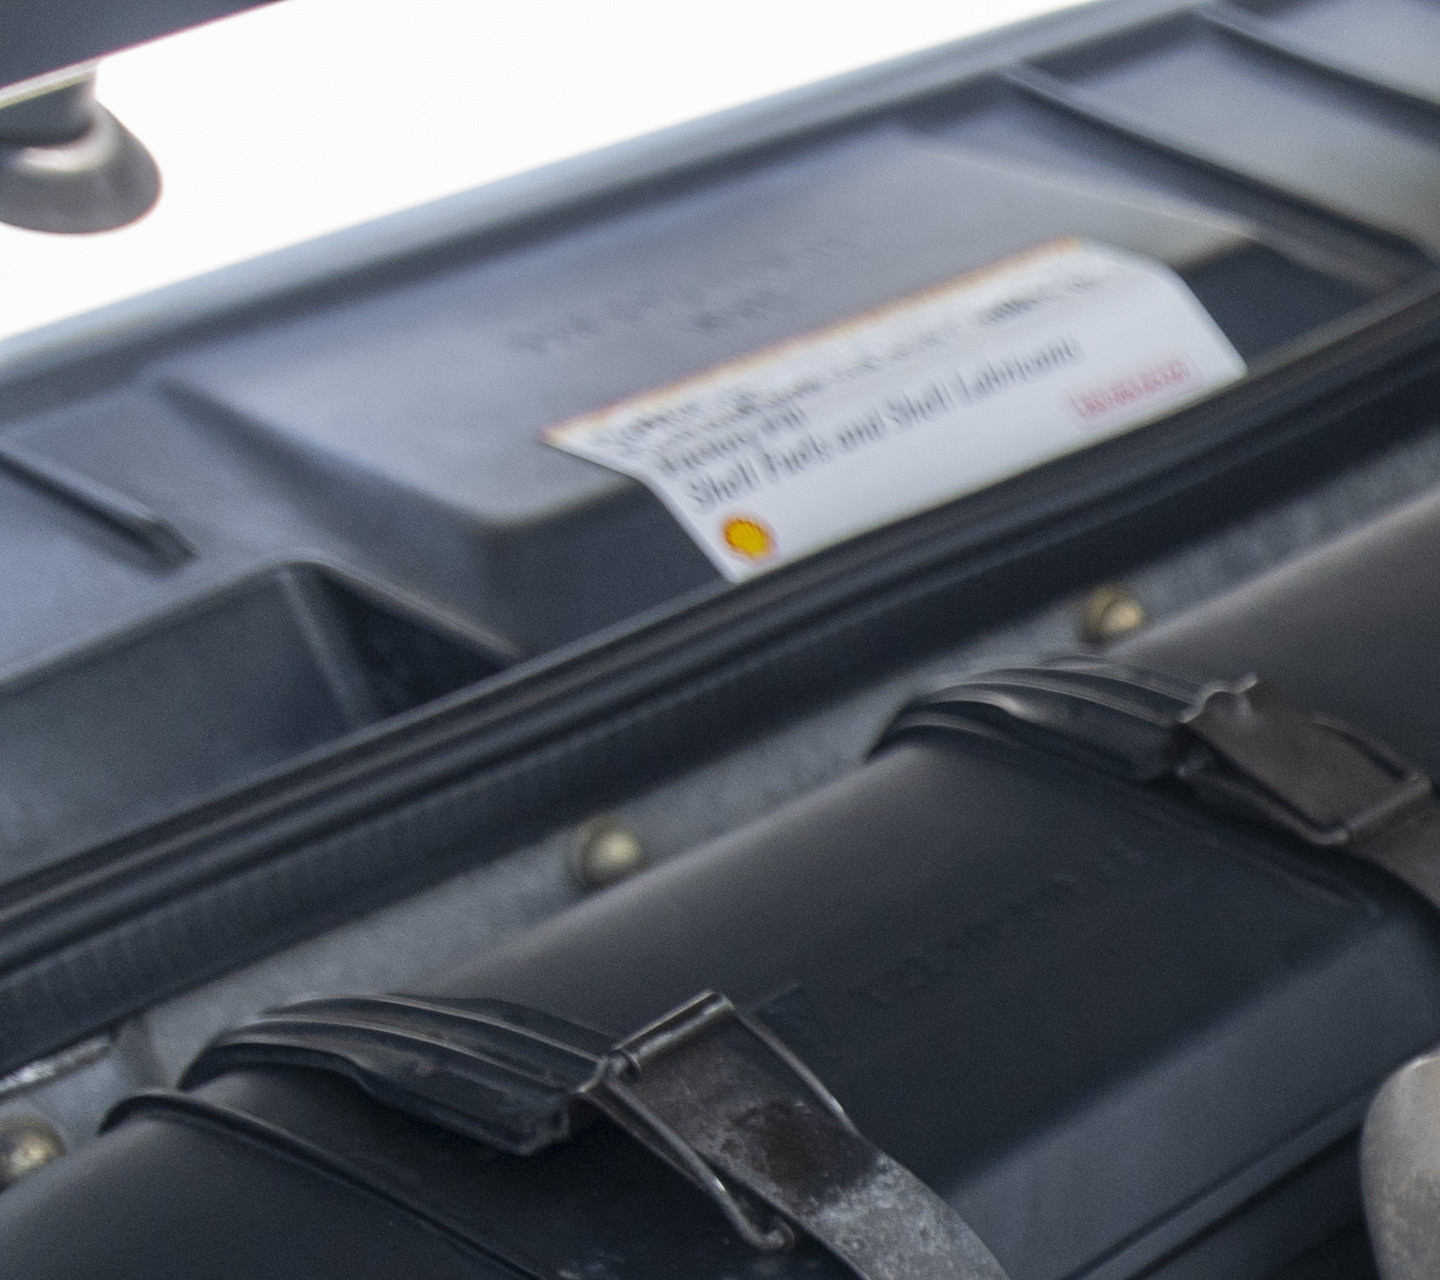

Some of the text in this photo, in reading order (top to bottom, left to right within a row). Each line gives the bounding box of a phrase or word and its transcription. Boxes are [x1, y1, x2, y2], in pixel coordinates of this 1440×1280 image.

[690, 461, 758, 508] Shell
[762, 435, 832, 480] Fuels
[835, 411, 887, 452] and
[884, 382, 953, 432] Shell
